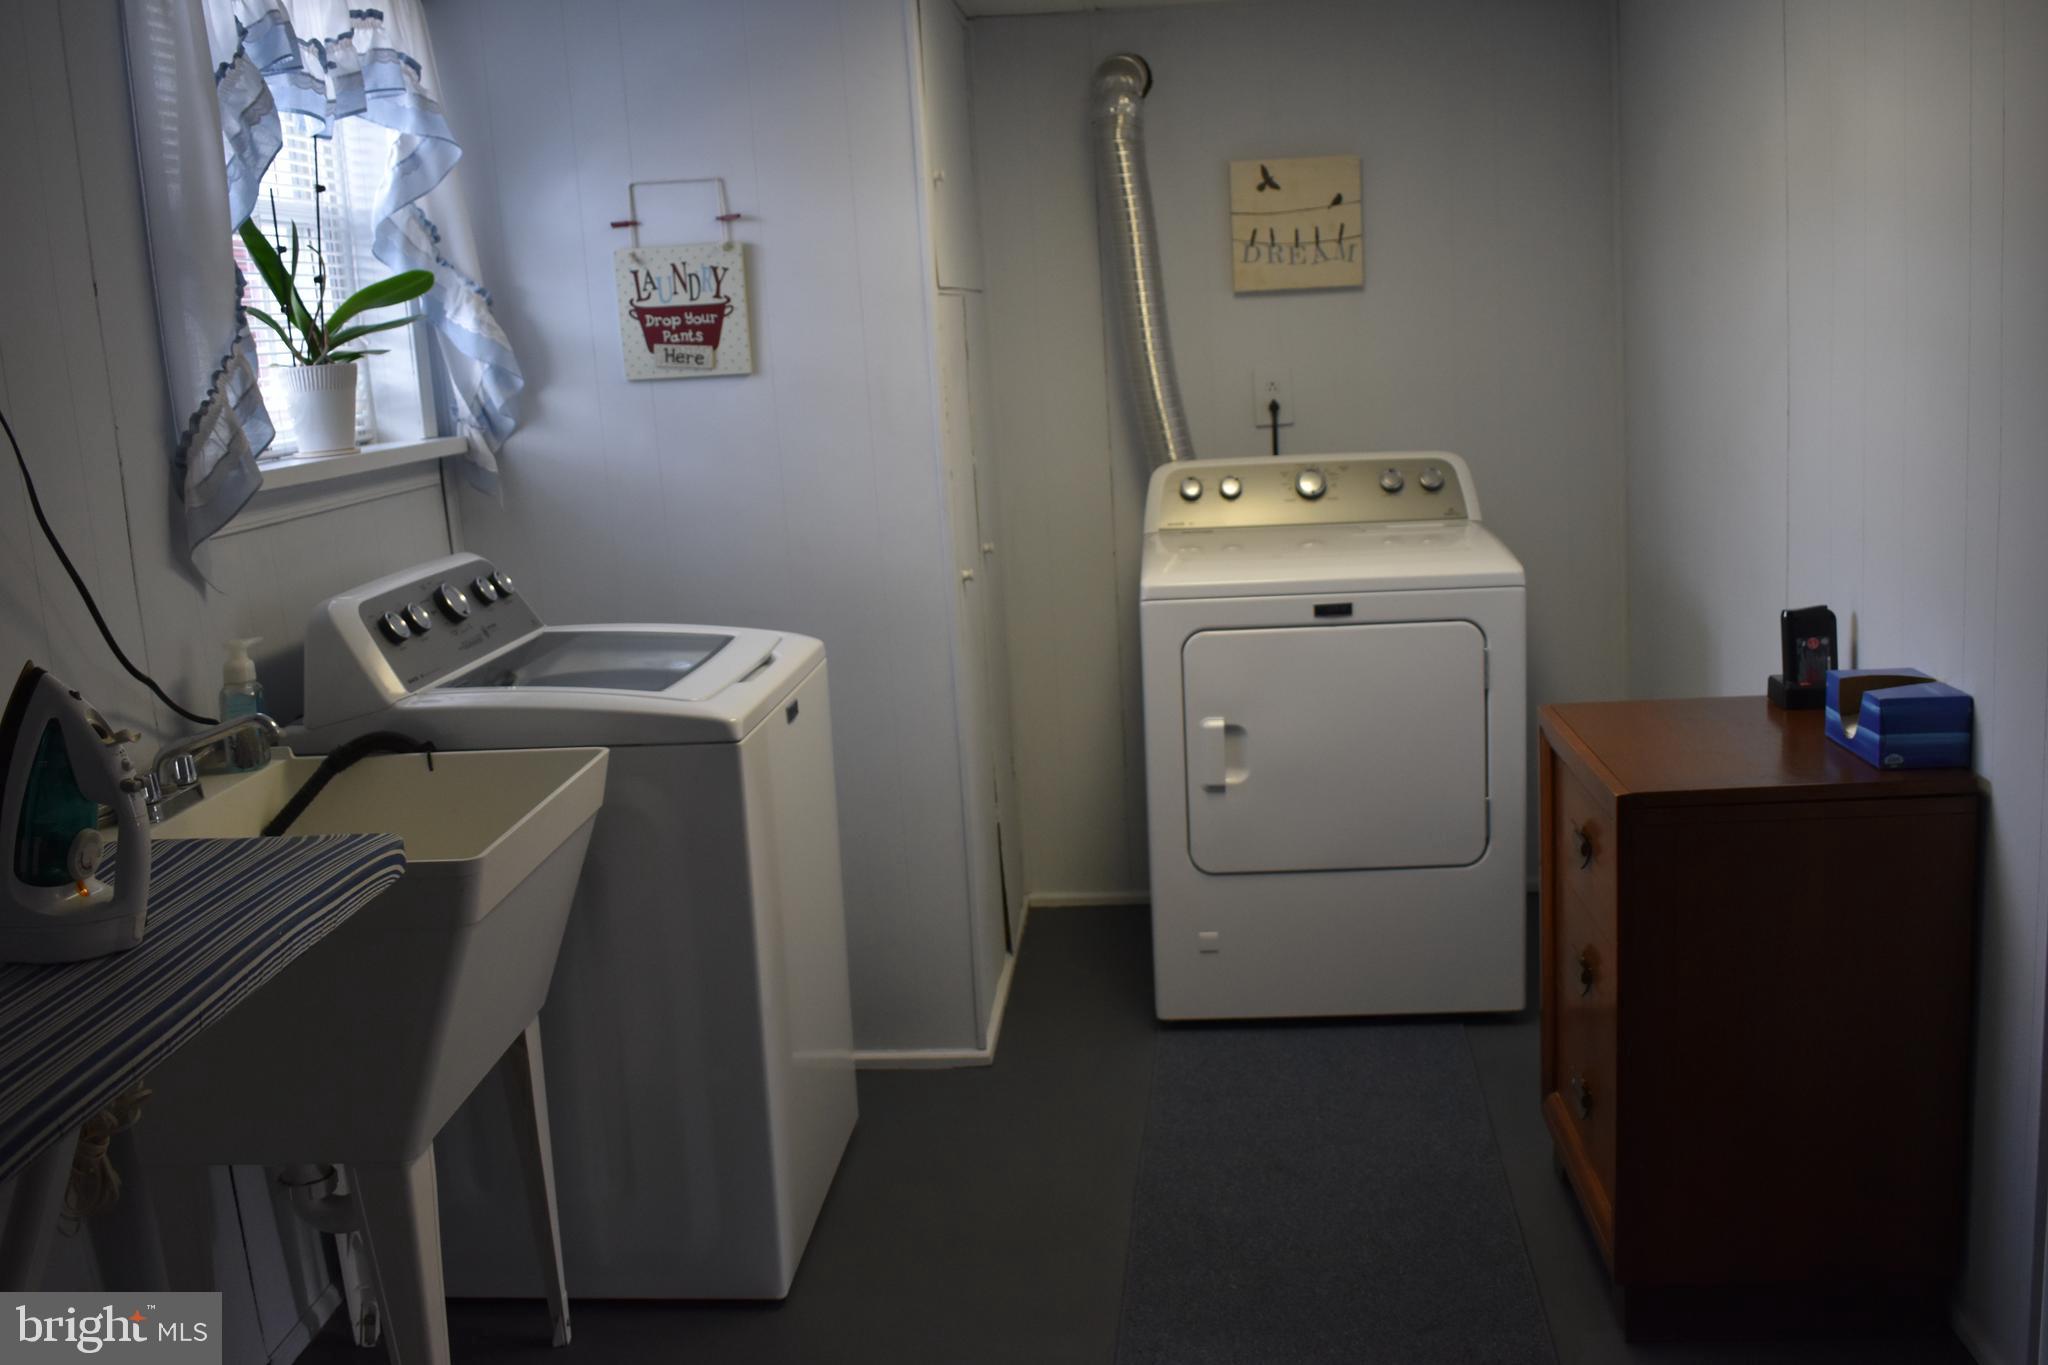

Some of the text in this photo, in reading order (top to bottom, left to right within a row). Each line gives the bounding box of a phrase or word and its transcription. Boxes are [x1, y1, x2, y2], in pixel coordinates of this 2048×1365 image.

[1241, 242, 1358, 266] DREAM
[630, 261, 729, 303] LAUNDRY
[645, 311, 718, 329] Drop Your
[662, 329, 704, 344] Pants
[663, 347, 705, 366] Here
